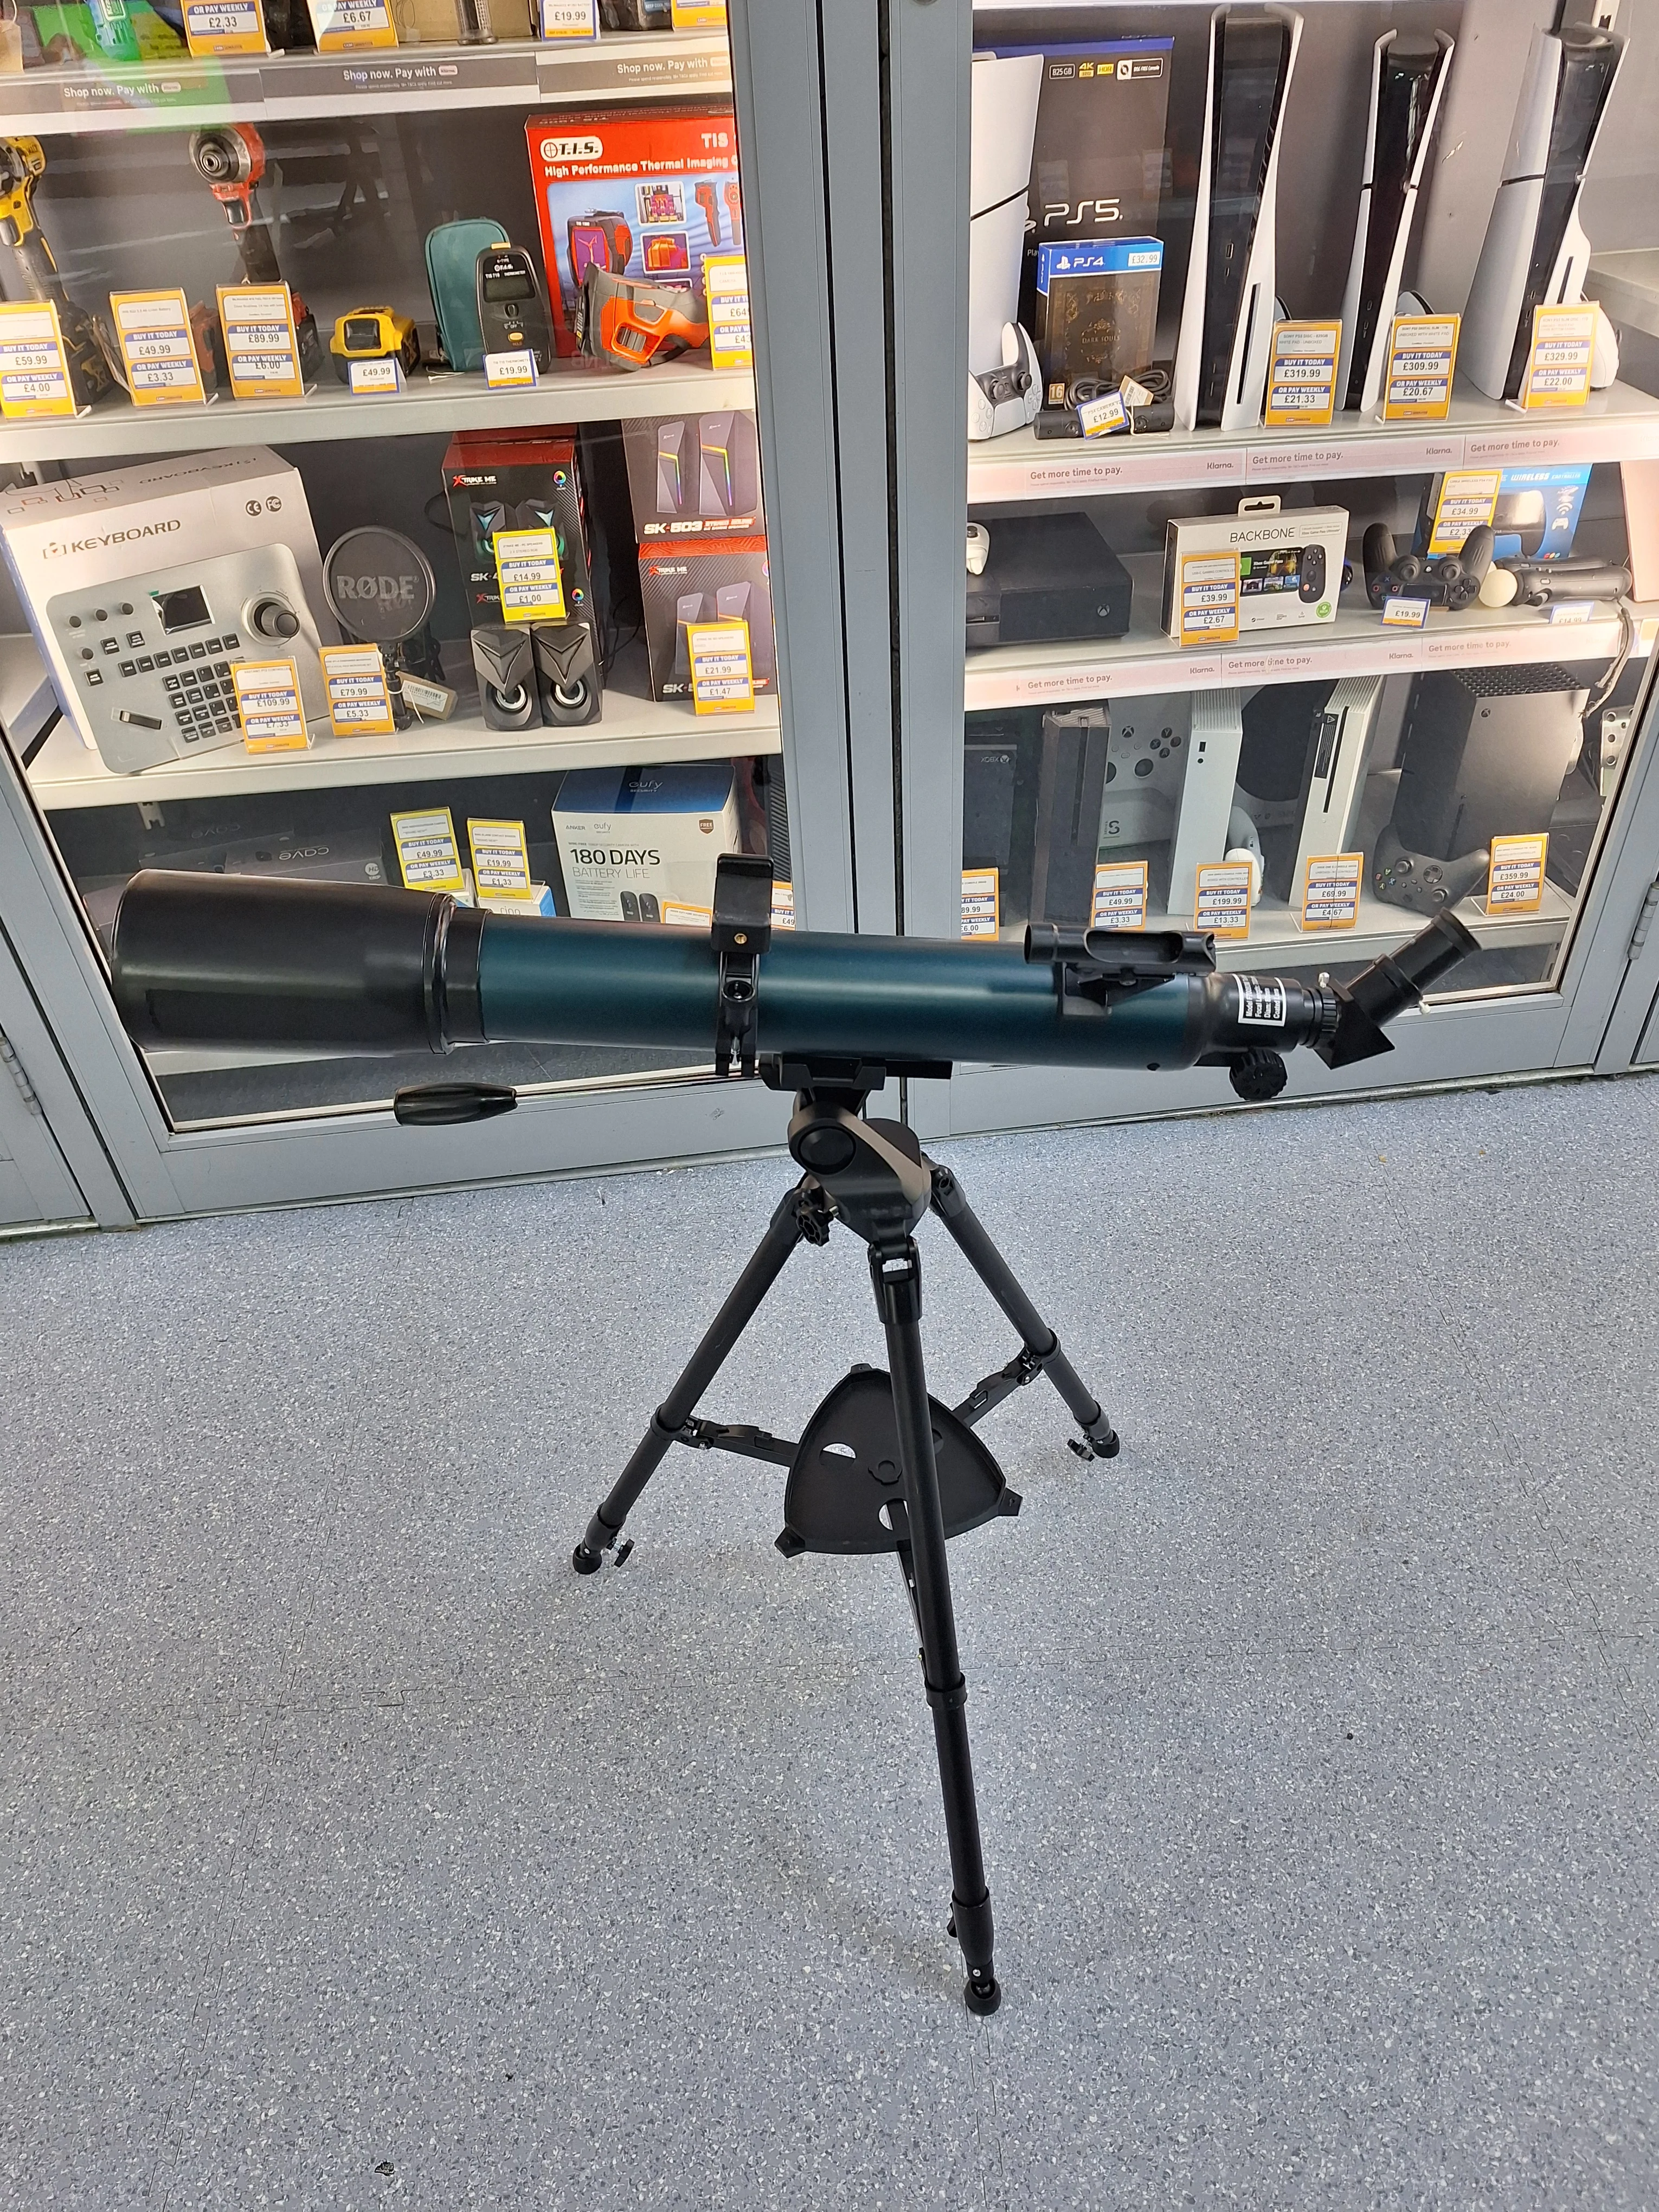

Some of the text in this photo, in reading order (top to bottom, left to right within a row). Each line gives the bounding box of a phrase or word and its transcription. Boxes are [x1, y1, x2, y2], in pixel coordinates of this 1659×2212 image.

[194, 3, 248, 14] OR PAY WEEKLY
[343, 11, 371, 23] £6.67
[555, 11, 586, 21] £19.99
[209, 16, 237, 28] £2.33
[618, 57, 708, 75] Shop now. Pay with
[343, 65, 436, 82] Shop now. Pay with
[63, 83, 159, 98] Shop now. Pay with
[701, 132, 729, 149] TIS
[558, 142, 599, 156] T.I.S.
[545, 156, 728, 178] High Performance Thermal Imaging
[1044, 198, 1120, 227] PS5
[1073, 256, 1104, 267] PS4
[1132, 254, 1158, 263] £32.99
[248, 334, 280, 343] £89.99
[139, 344, 171, 356] £49.99
[15, 355, 48, 366] £59.99
[1545, 352, 1578, 361] £329.99
[363, 367, 391, 376] £49.99
[499, 365, 528, 375] £19.99
[1403, 362, 1438, 371] £309.99
[147, 372, 173, 382] £3.33
[1284, 369, 1321, 378] £319.99
[1545, 377, 1572, 386] £22.00
[24, 383, 50, 393] £4.00
[1051, 384, 1063, 397] 16
[1403, 387, 1433, 396] £20.67
[1284, 395, 1315, 403] £21.33
[1094, 408, 1119, 423] £12.99
[1426, 447, 1452, 455] Klarna.
[1252, 455, 1268, 464] Get
[1270, 454, 1291, 462] more
[1294, 452, 1313, 461] time
[1326, 452, 1343, 460] pay.
[1511, 472, 1550, 481] WIRELESS
[644, 520, 703, 535] SK-503
[72, 519, 181, 553] KEYBOARD
[1230, 527, 1296, 543] BACKBONE
[514, 572, 541, 581] £14.99
[337, 575, 415, 600] RØDE
[519, 594, 541, 603] £1.00
[1201, 593, 1227, 603] £39.99
[1395, 610, 1420, 618] £19.99
[1203, 616, 1225, 624] £2.67
[705, 666, 731, 674] £21.99
[1028, 681, 1043, 689] Get
[1044, 679, 1064, 688] more
[1066, 677, 1084, 685] time
[1096, 674, 1113, 684] pay.
[340, 687, 368, 696] £79.99
[710, 687, 731, 696] £1.47
[257, 698, 290, 707] £109.99
[346, 710, 369, 718] £5.33
[629, 780, 664, 789] eufy
[594, 822, 612, 831] eufy
[1109, 820, 1120, 835] S
[278, 846, 330, 861] cave
[417, 849, 443, 859] £49.99
[570, 849, 660, 865] 180 DAYS
[487, 859, 511, 867] £19.99
[423, 869, 445, 878] £3.33
[573, 867, 651, 879] BATTERY LIFE
[1500, 872, 1528, 880] £359.99
[1109, 898, 1133, 906] £49.99
[1213, 897, 1242, 905] £199.99
